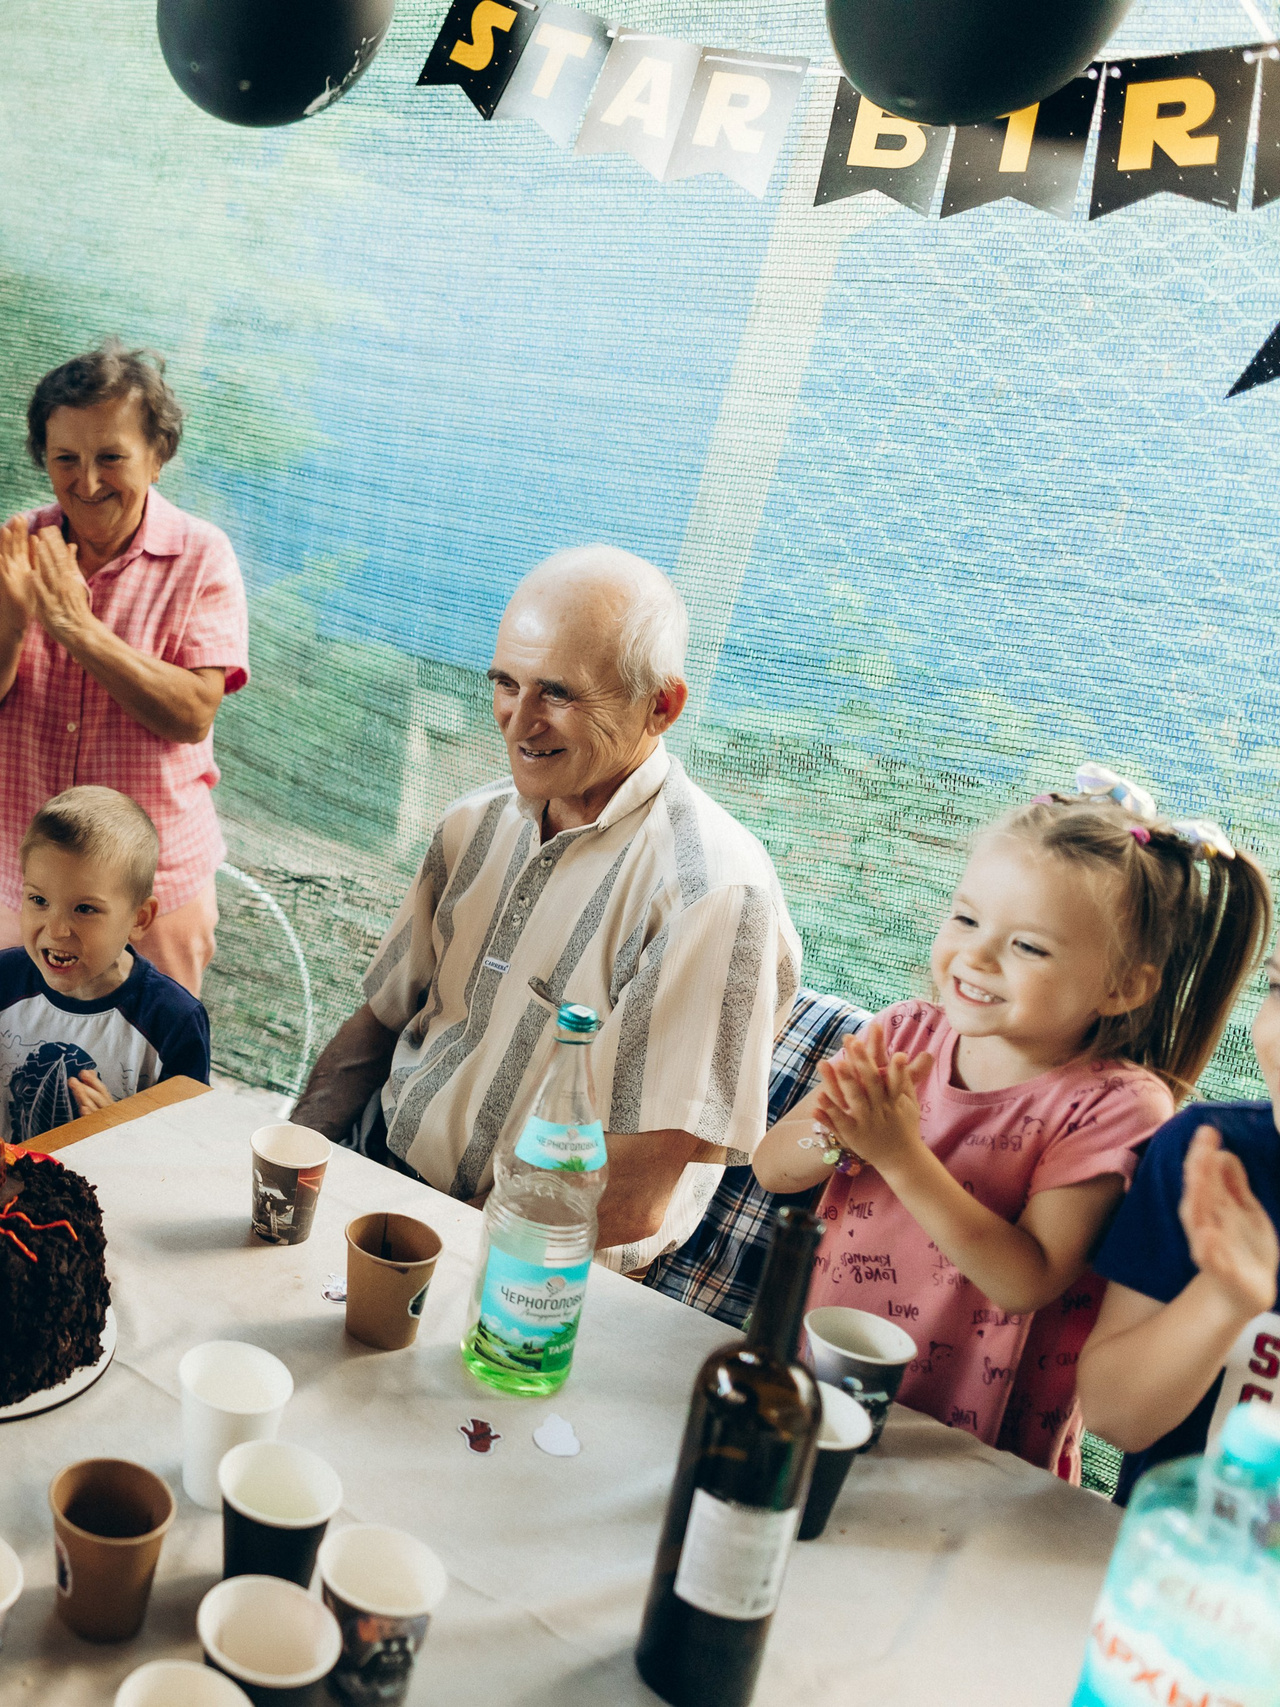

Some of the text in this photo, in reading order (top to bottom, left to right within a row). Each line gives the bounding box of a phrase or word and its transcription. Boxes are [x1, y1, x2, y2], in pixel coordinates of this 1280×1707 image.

[449, 0, 771, 154] STAR
[847, 1198, 874, 1219] SMILE
[888, 1300, 920, 1322] Love
